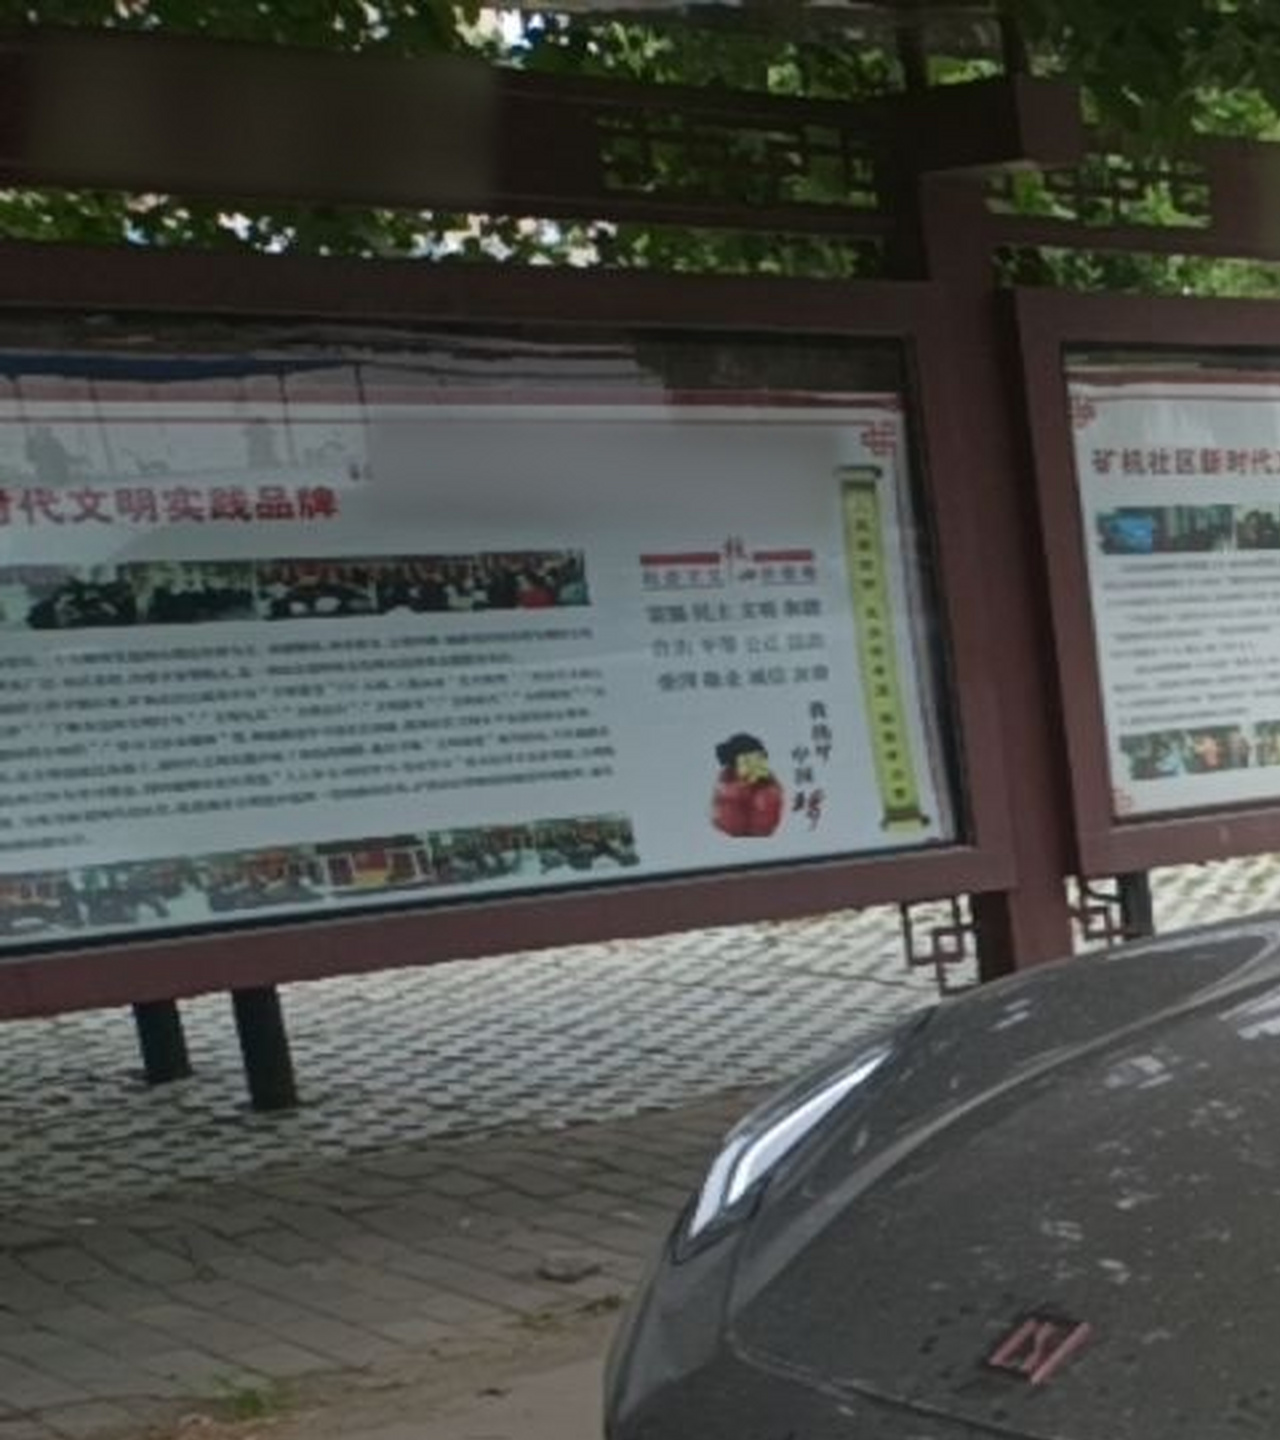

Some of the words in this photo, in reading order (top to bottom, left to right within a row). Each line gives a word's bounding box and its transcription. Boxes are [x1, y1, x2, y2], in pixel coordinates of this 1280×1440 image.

[0, 485, 341, 525] 代文明实践品牌
